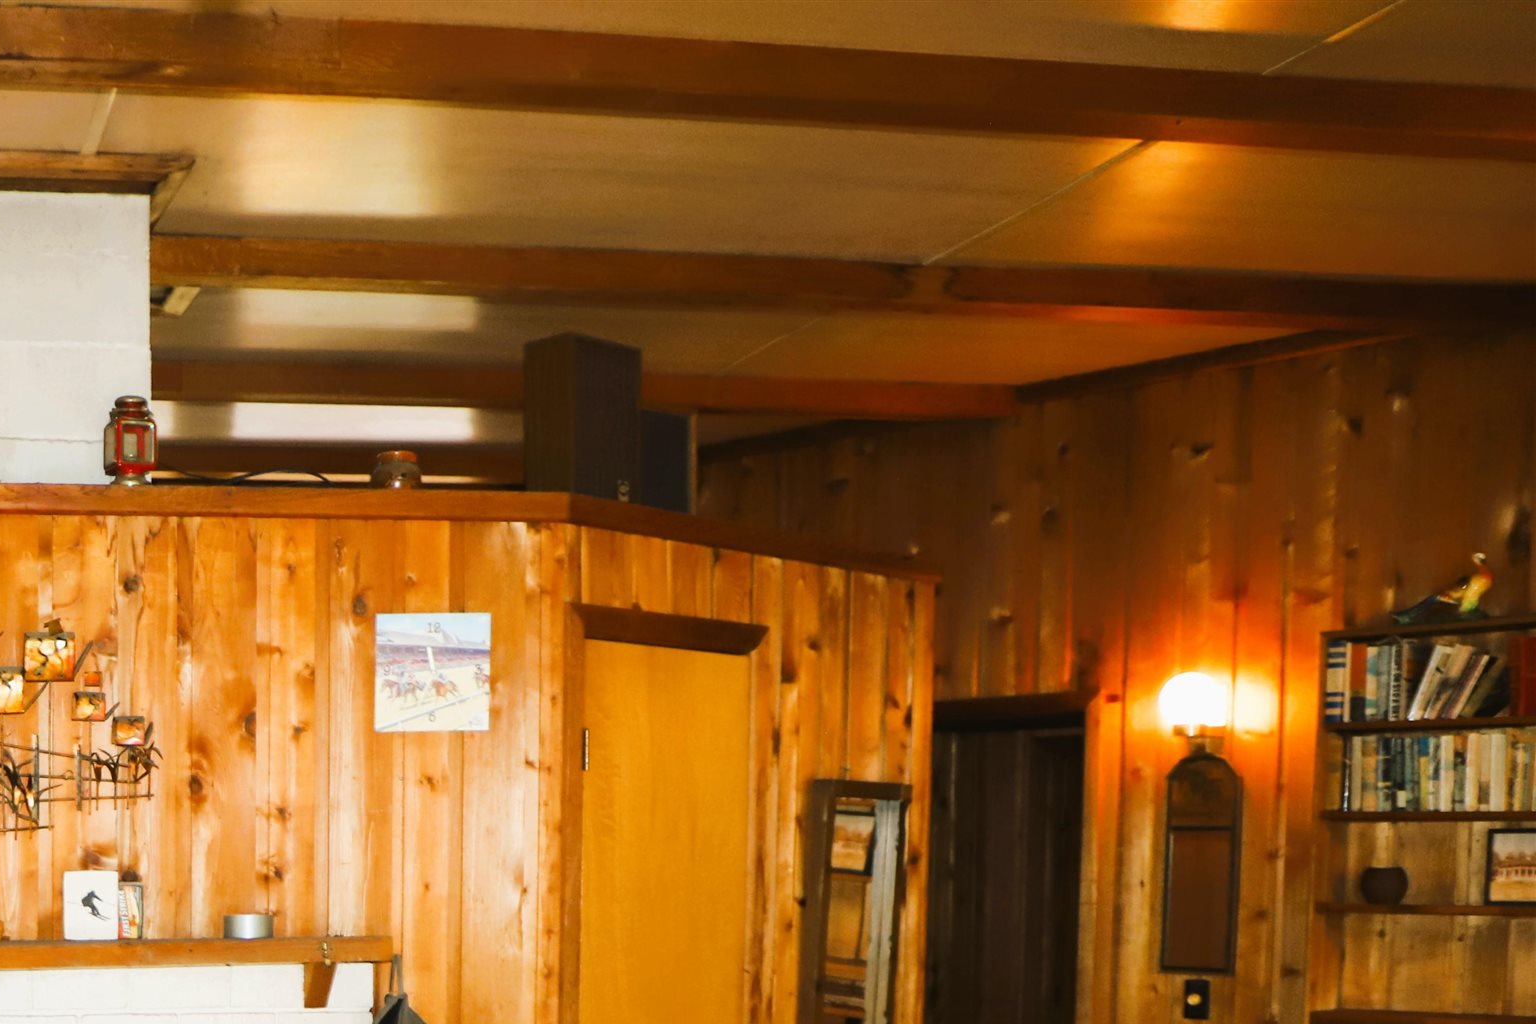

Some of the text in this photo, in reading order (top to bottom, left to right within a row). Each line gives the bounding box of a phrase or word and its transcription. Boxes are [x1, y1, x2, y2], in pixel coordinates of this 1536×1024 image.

[427, 622, 441, 634] 12
[383, 664, 392, 676] 9
[474, 663, 482, 675] 3
[429, 711, 437, 722] 6
